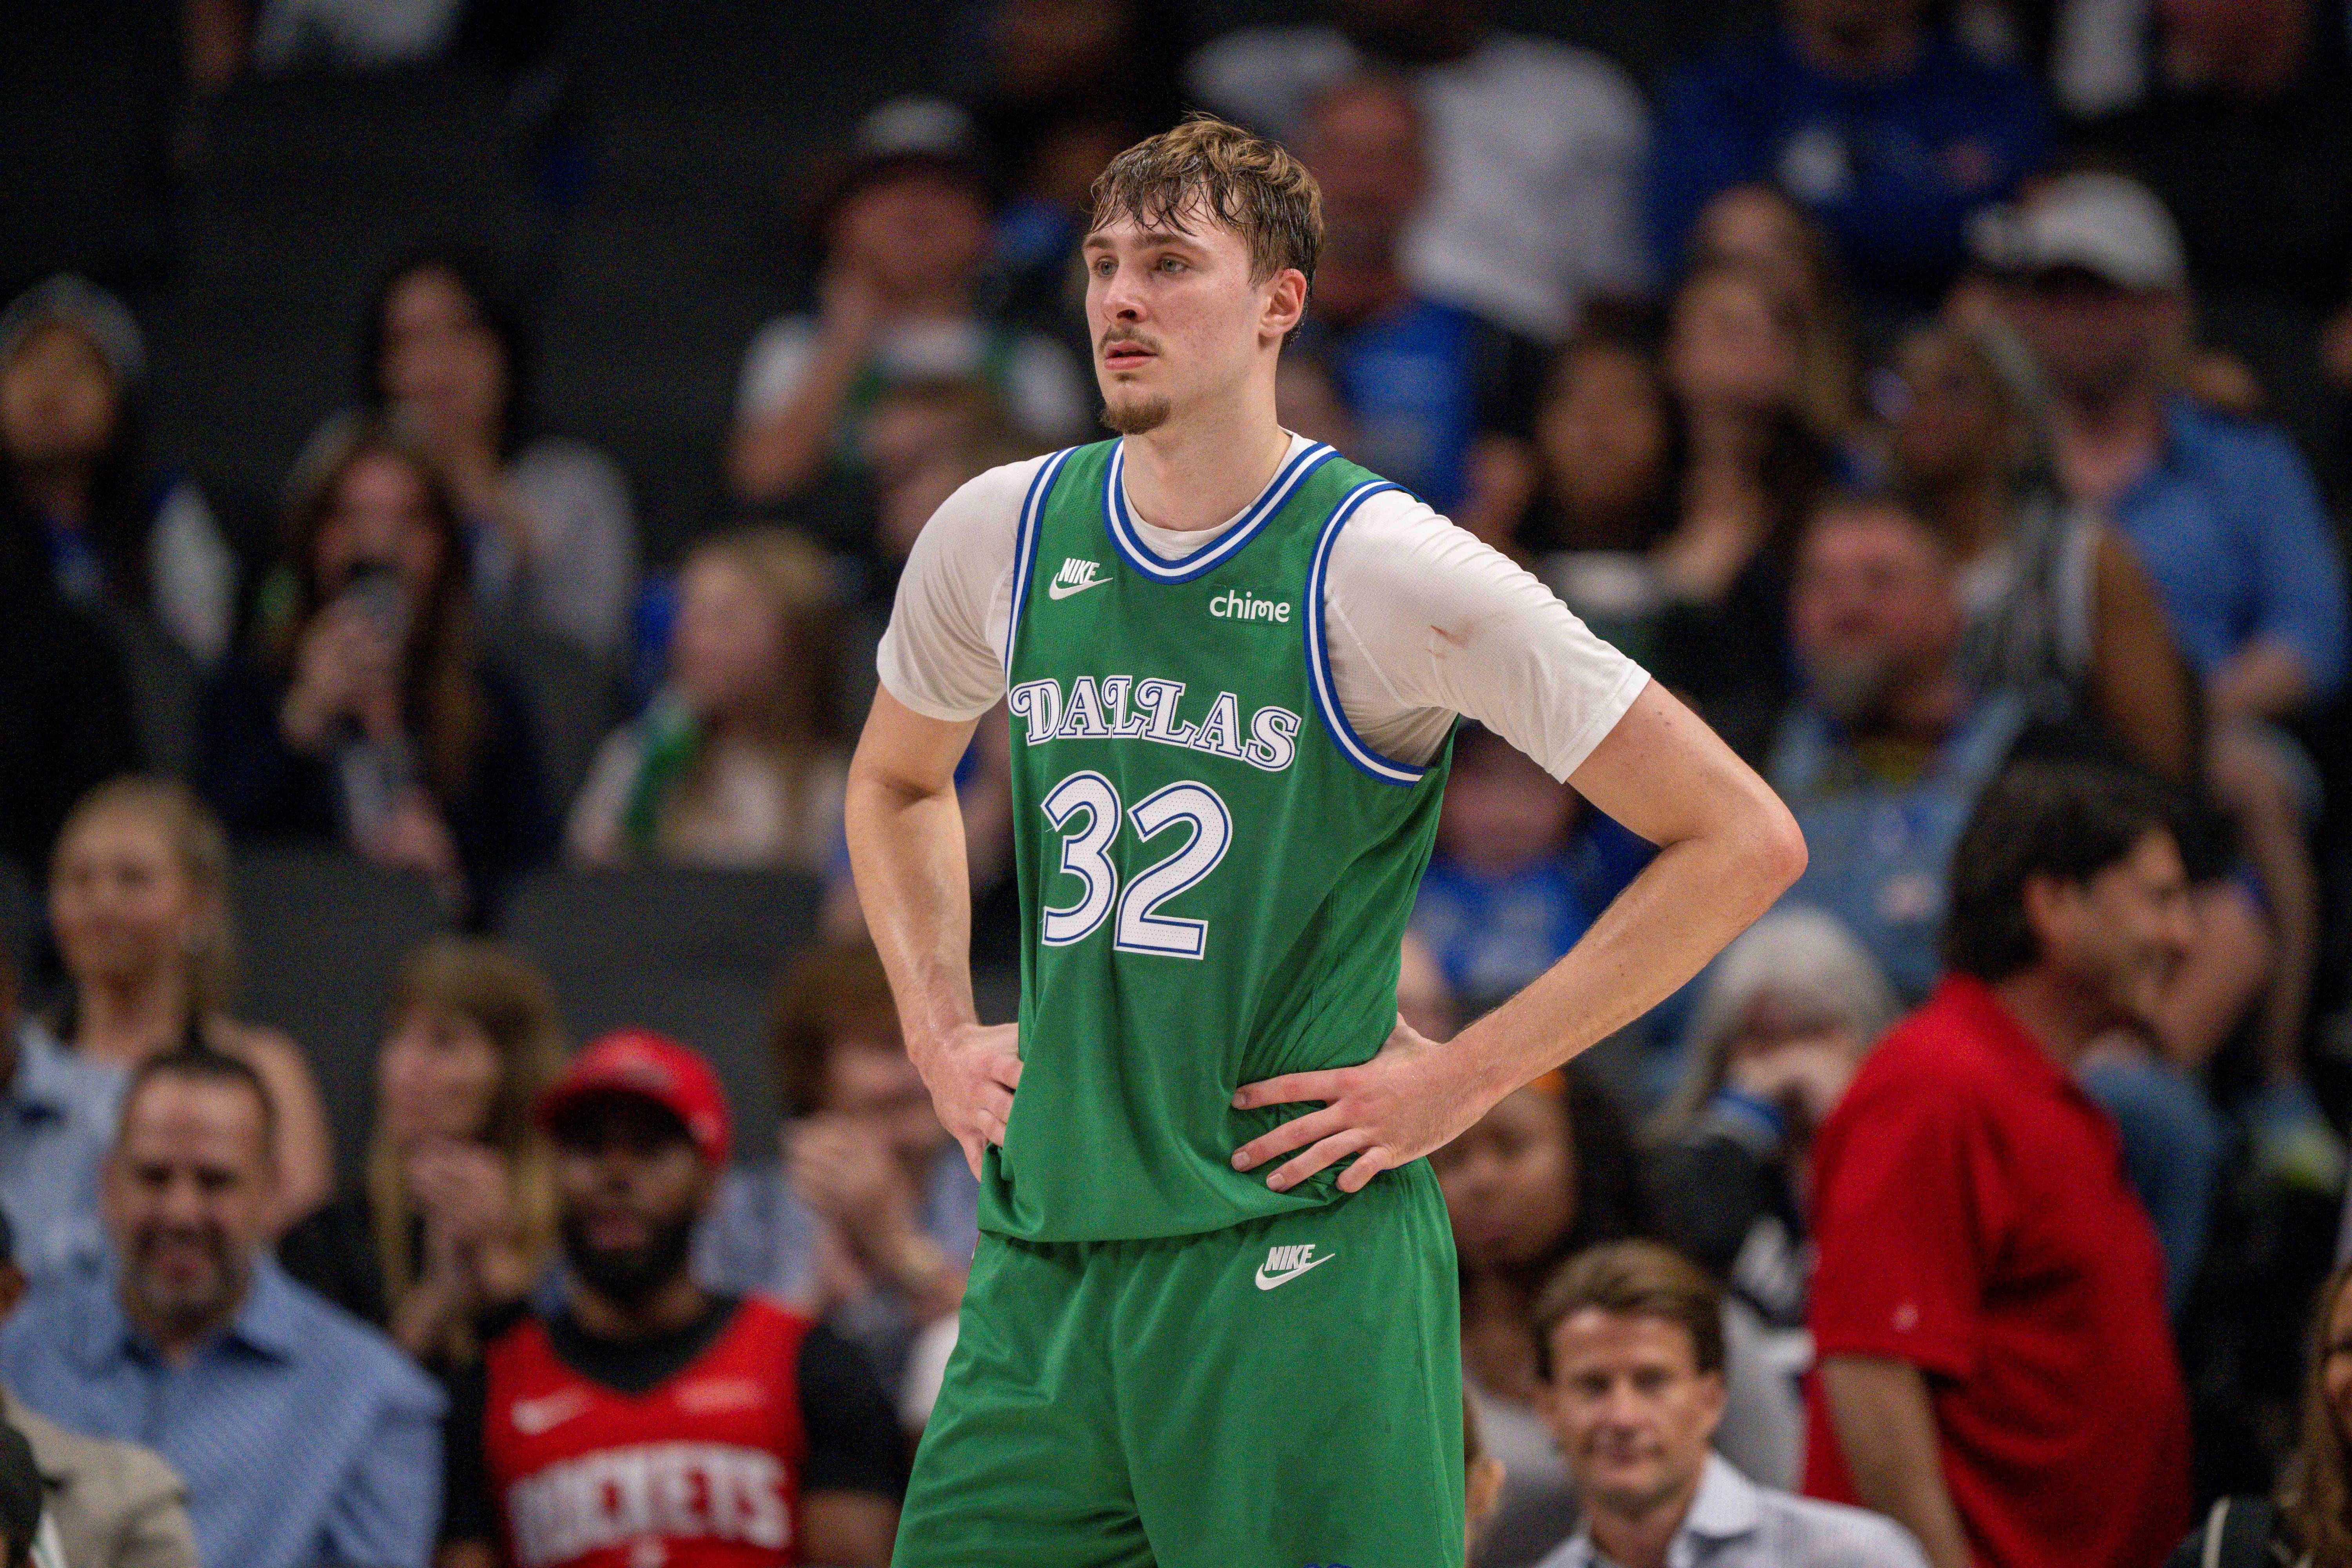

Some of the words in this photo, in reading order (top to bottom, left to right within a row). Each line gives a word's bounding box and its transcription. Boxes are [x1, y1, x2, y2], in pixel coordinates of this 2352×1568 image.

[1058, 557, 1100, 584] NIKE
[1210, 589, 1290, 622] chime
[1008, 675, 1301, 771] DALLAS
[1040, 769, 1233, 960] 32
[1264, 1244, 1316, 1271] NIKE
